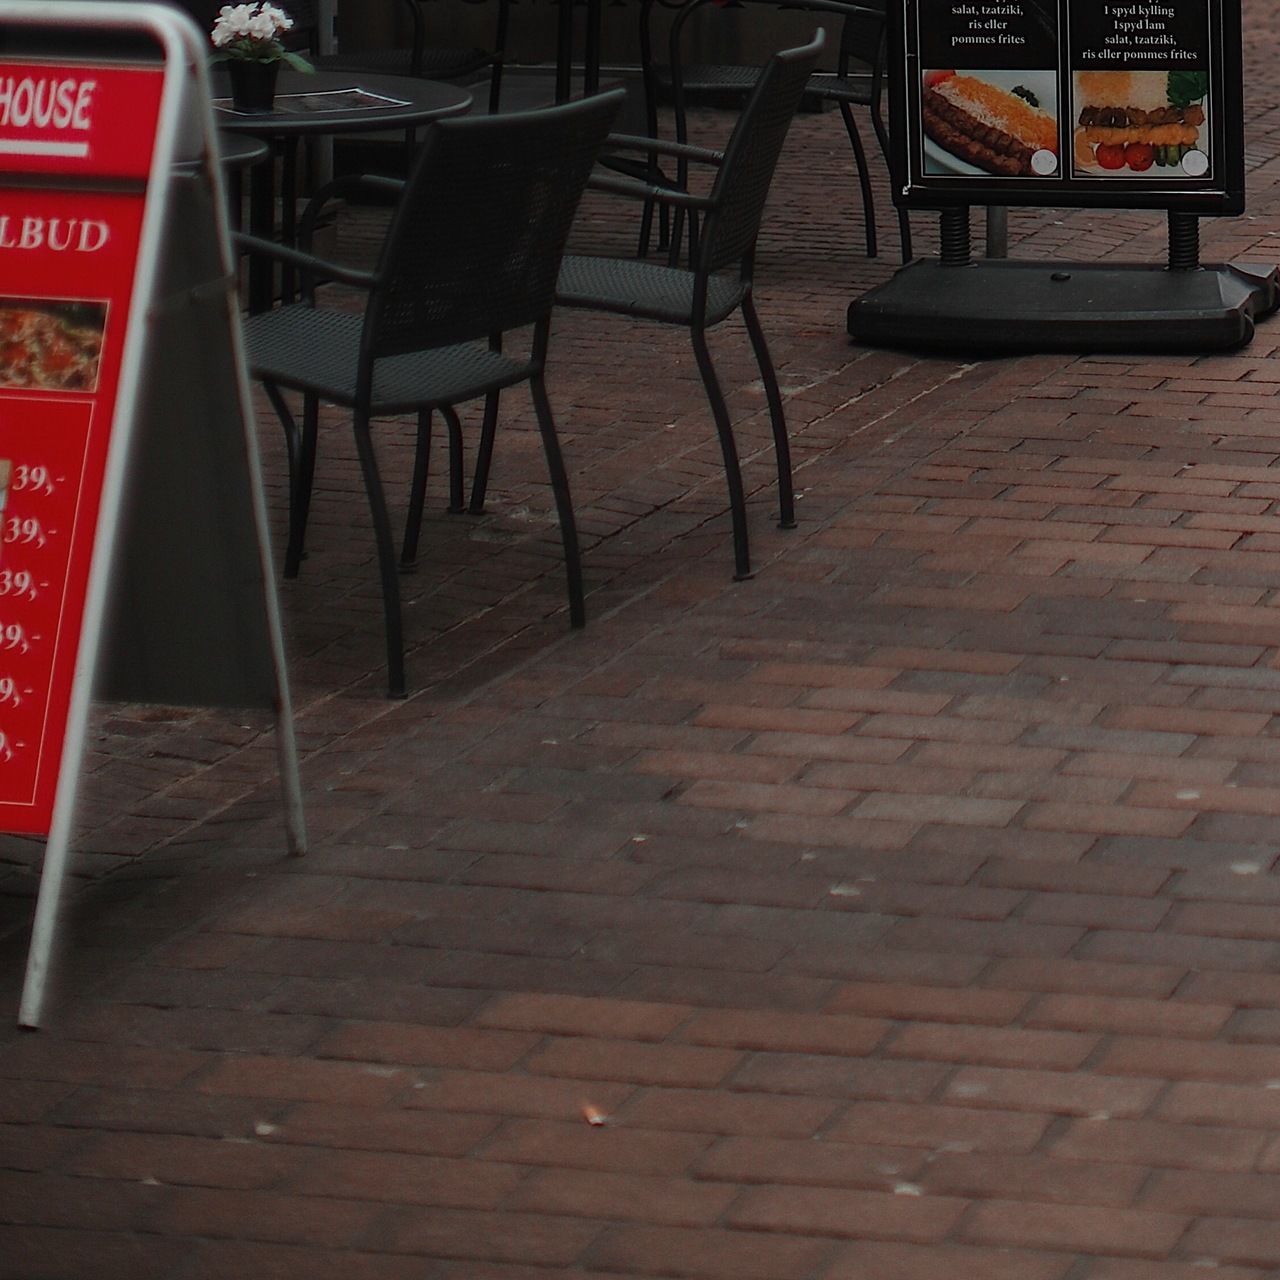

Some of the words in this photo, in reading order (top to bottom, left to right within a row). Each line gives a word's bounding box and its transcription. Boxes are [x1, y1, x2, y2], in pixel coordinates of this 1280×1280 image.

[951, 4, 979, 15] salat,
[981, 4, 1024, 16] tzatziki,
[1112, 5, 1136, 17] spyd
[1138, 5, 1175, 19] kylling
[968, 20, 982, 29] ris
[984, 19, 1008, 29] eller
[1145, 19, 1165, 30] lam
[951, 36, 996, 46] pommes
[998, 33, 1026, 44] frites
[1104, 34, 1133, 46] salat,
[1134, 35, 1177, 46] tzatziki,
[1082, 49, 1096, 59] ris
[1098, 48, 1121, 59] eller
[1123, 50, 1168, 61] pommes
[1170, 49, 1198, 60] frites
[0, 75, 97, 130] HOUSE
[0, 214, 112, 252] LBUD
[12, 464, 65, 497] 39,-
[6, 515, 58, 550] 39,-
